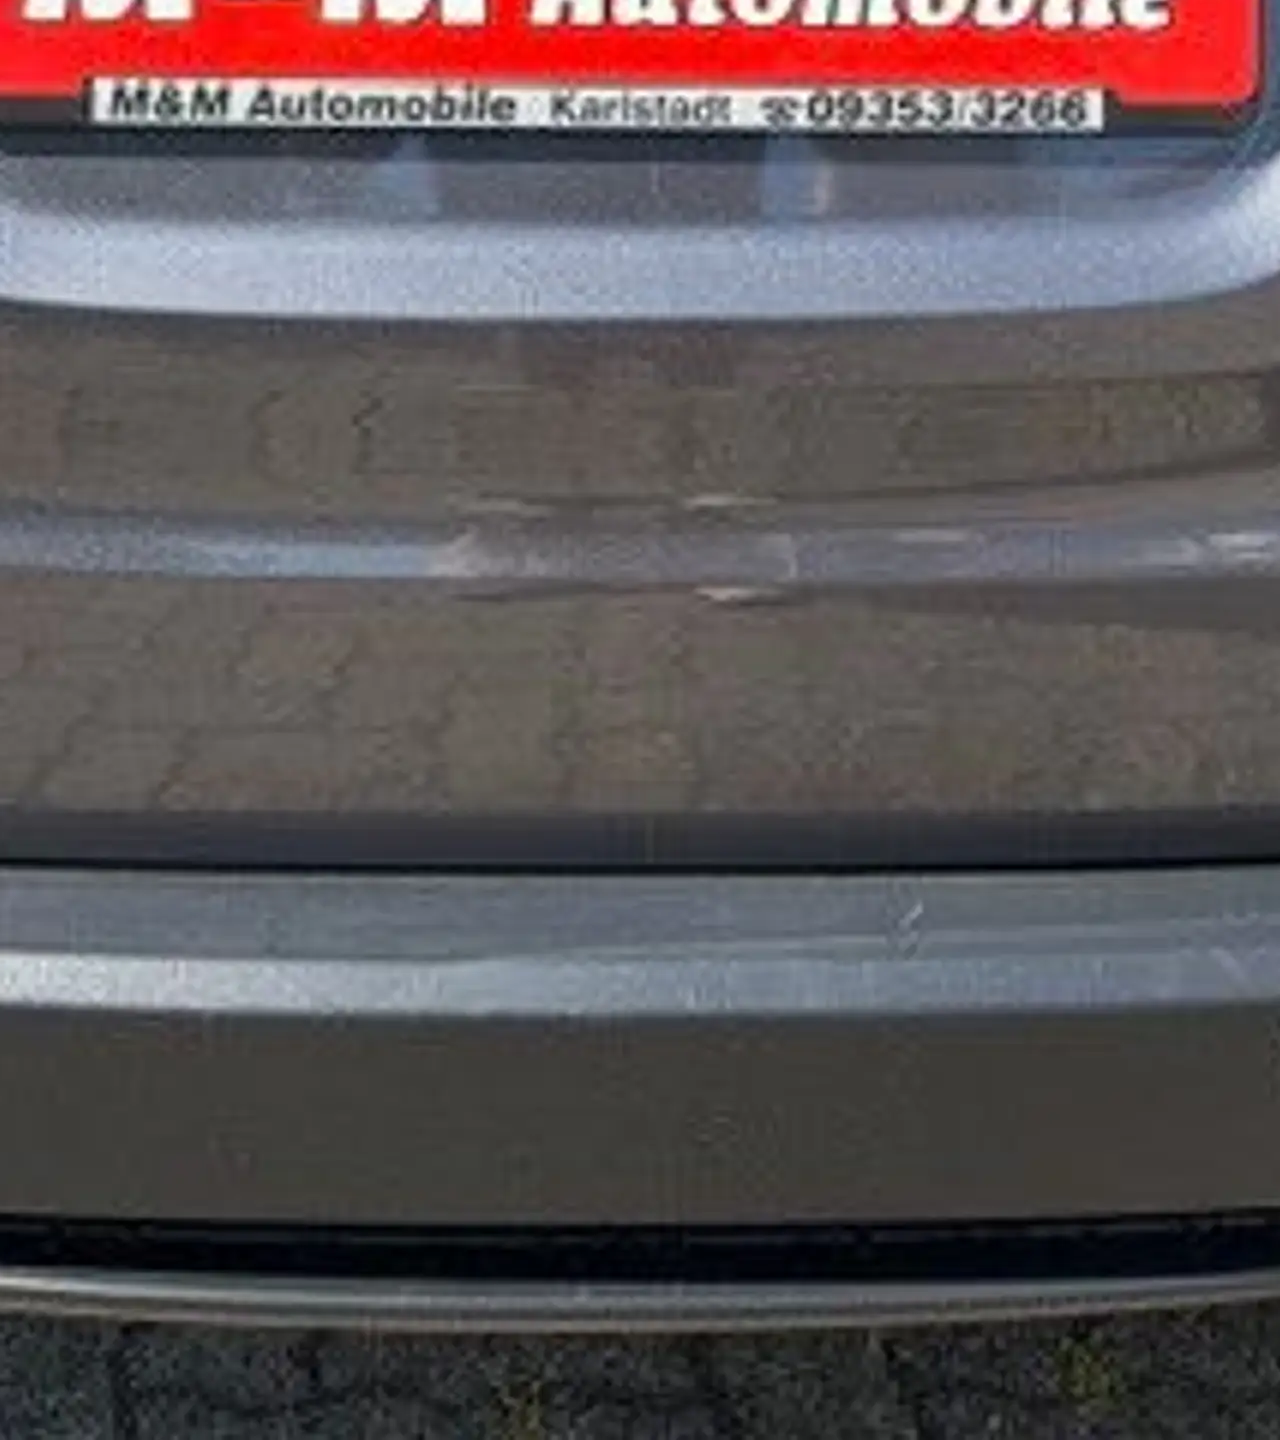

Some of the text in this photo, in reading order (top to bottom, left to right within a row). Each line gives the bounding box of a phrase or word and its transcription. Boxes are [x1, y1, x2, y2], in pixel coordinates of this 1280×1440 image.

[109, 84, 230, 122] M&M
[245, 85, 518, 123] Automobile
[549, 89, 732, 124] Karlstadt
